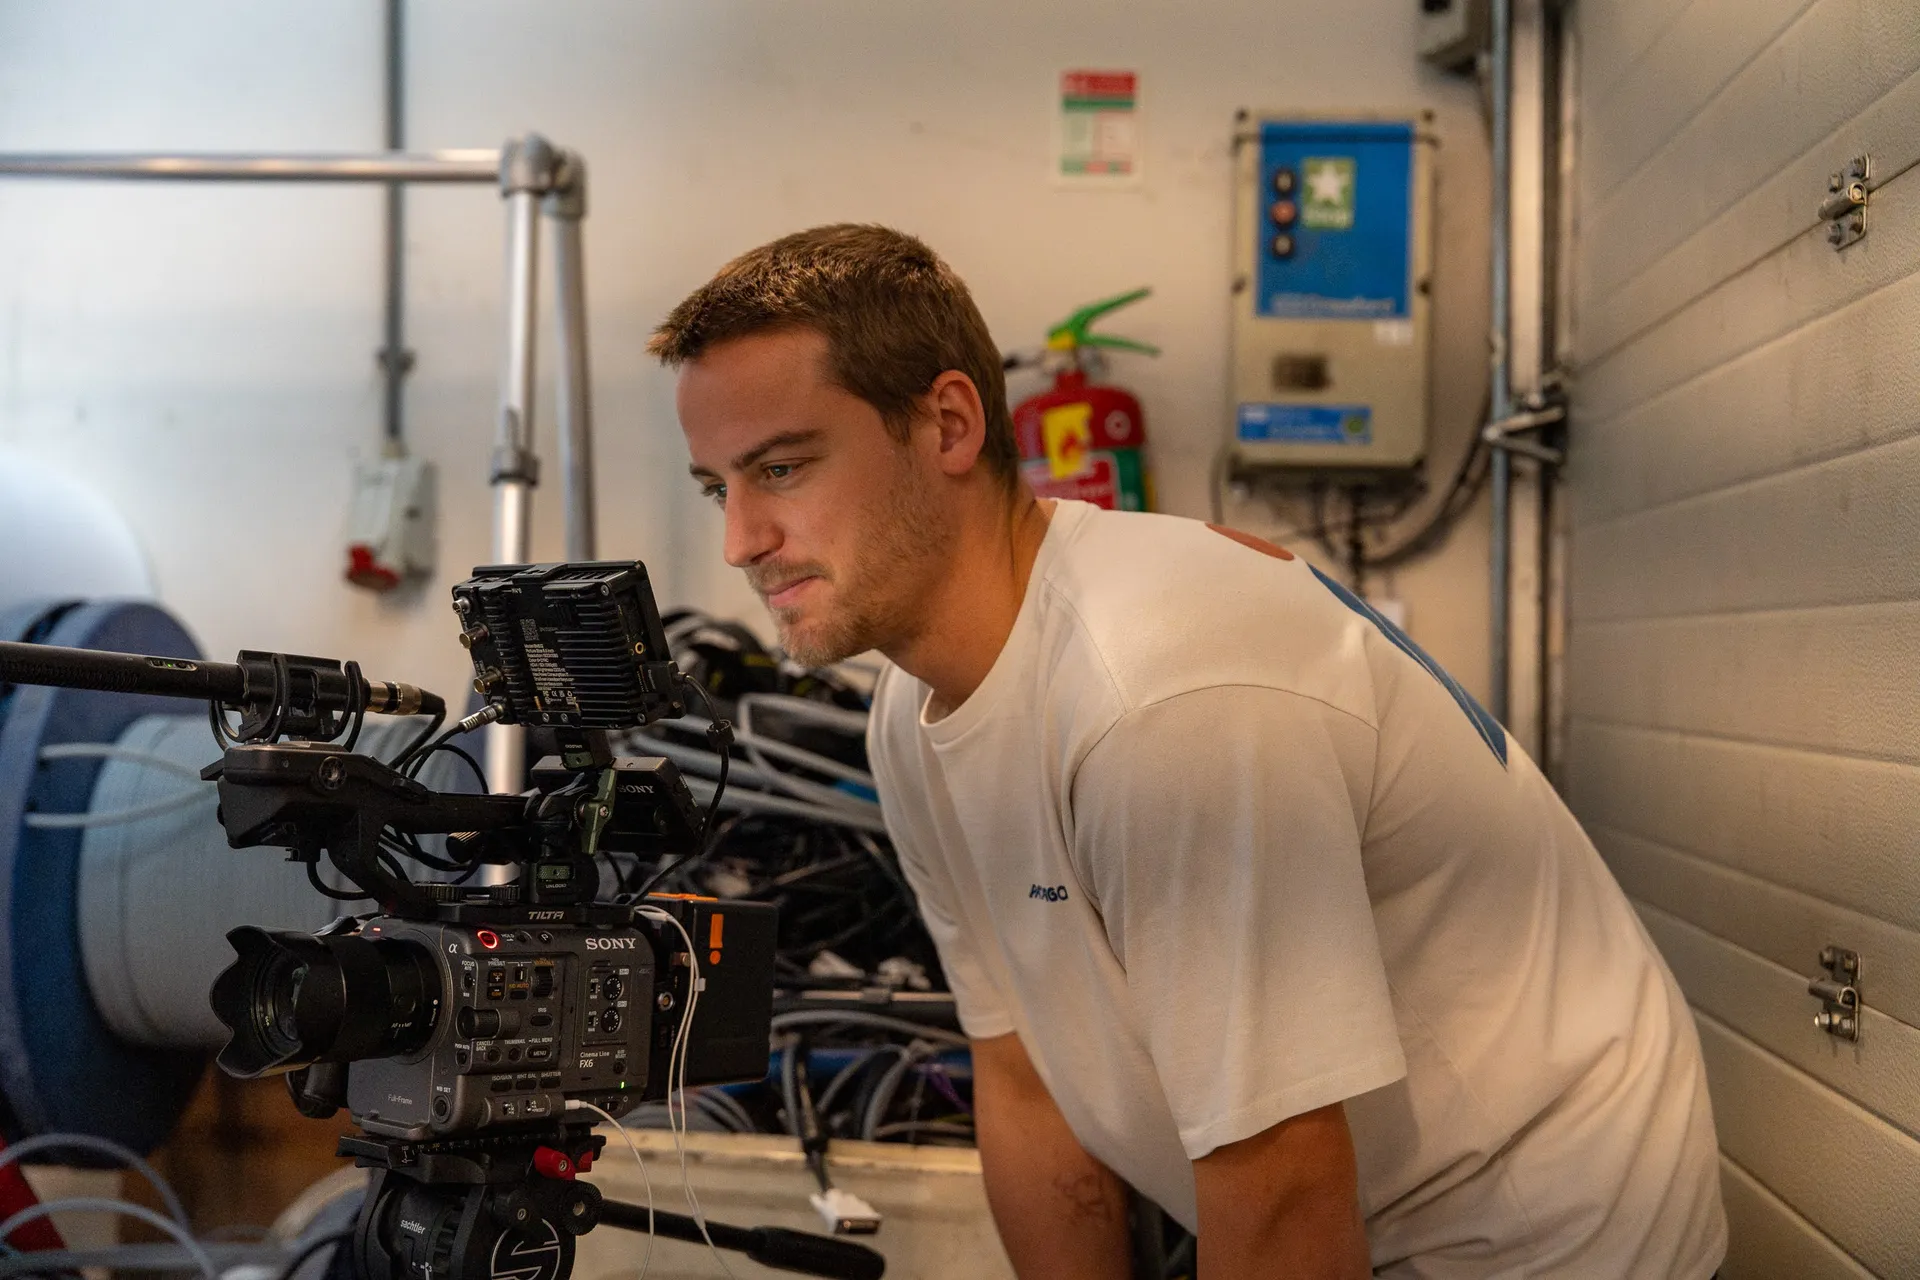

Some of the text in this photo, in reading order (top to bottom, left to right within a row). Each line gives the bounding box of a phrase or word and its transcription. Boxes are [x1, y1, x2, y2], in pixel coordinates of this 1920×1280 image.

[528, 911, 565, 920] TILTA
[585, 938, 636, 950] SONY
[580, 1059, 594, 1068] FX6
[400, 1219, 426, 1234] sachtler
